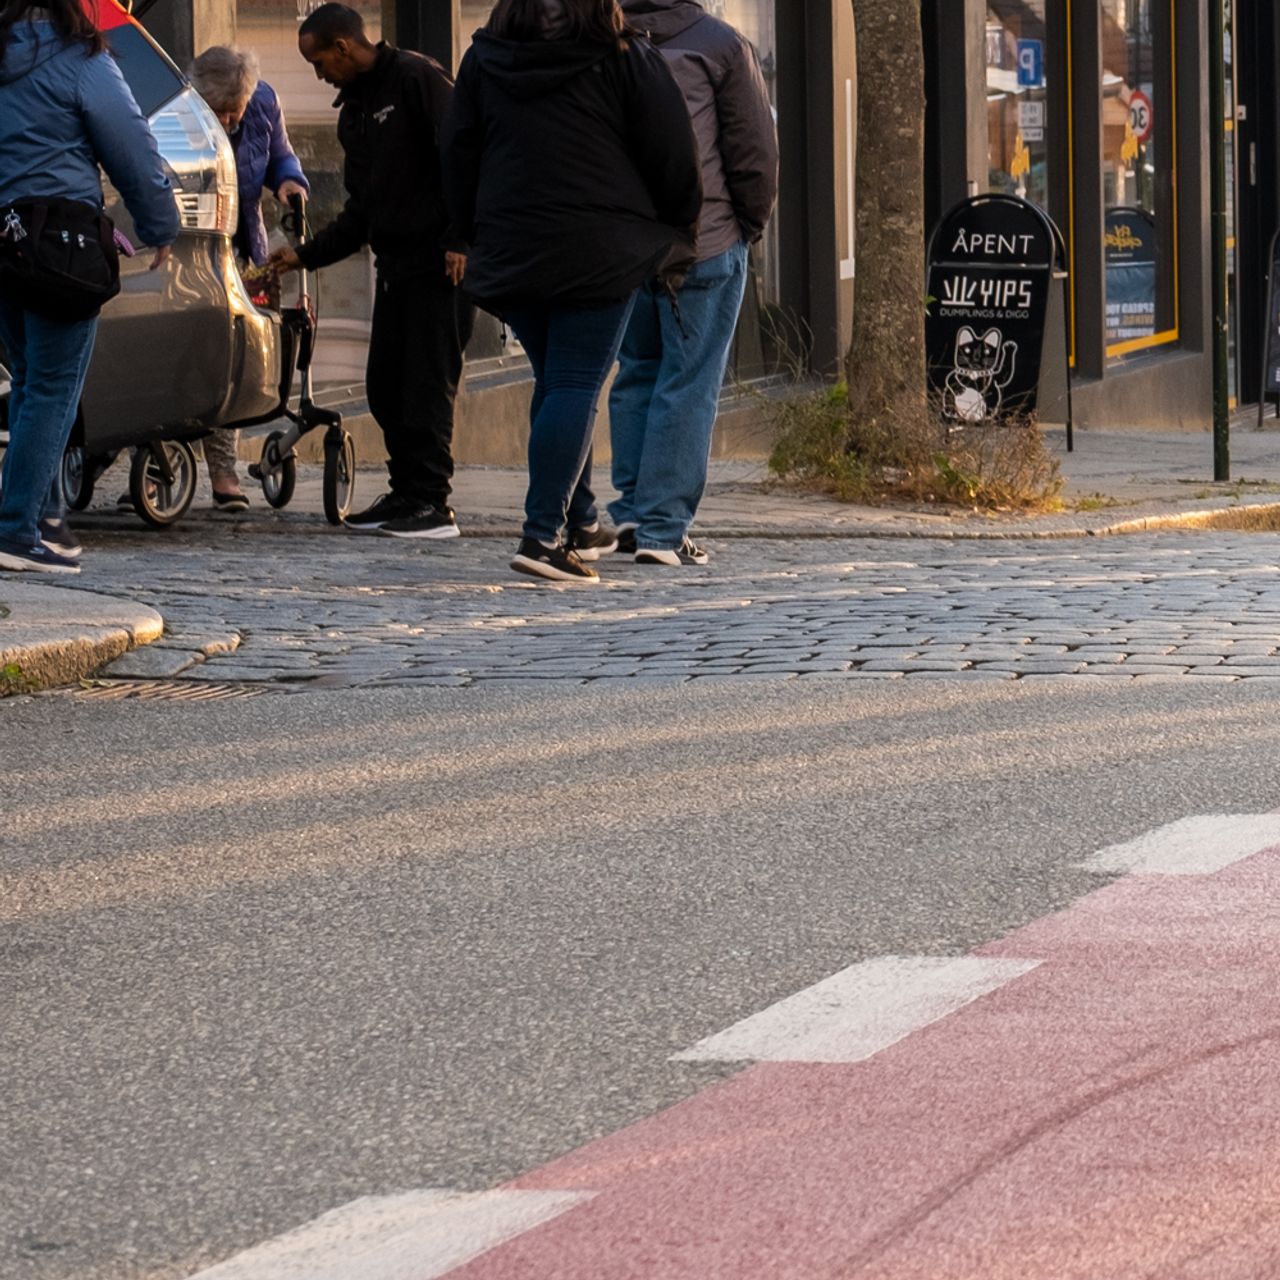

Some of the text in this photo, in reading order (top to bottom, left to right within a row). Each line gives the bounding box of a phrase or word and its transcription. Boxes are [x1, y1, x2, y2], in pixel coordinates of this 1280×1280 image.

[952, 228, 1034, 254] ÅPENT
[980, 280, 1032, 307] YIPS
[940, 308, 1029, 319] DUMPLINGS & DIGG
